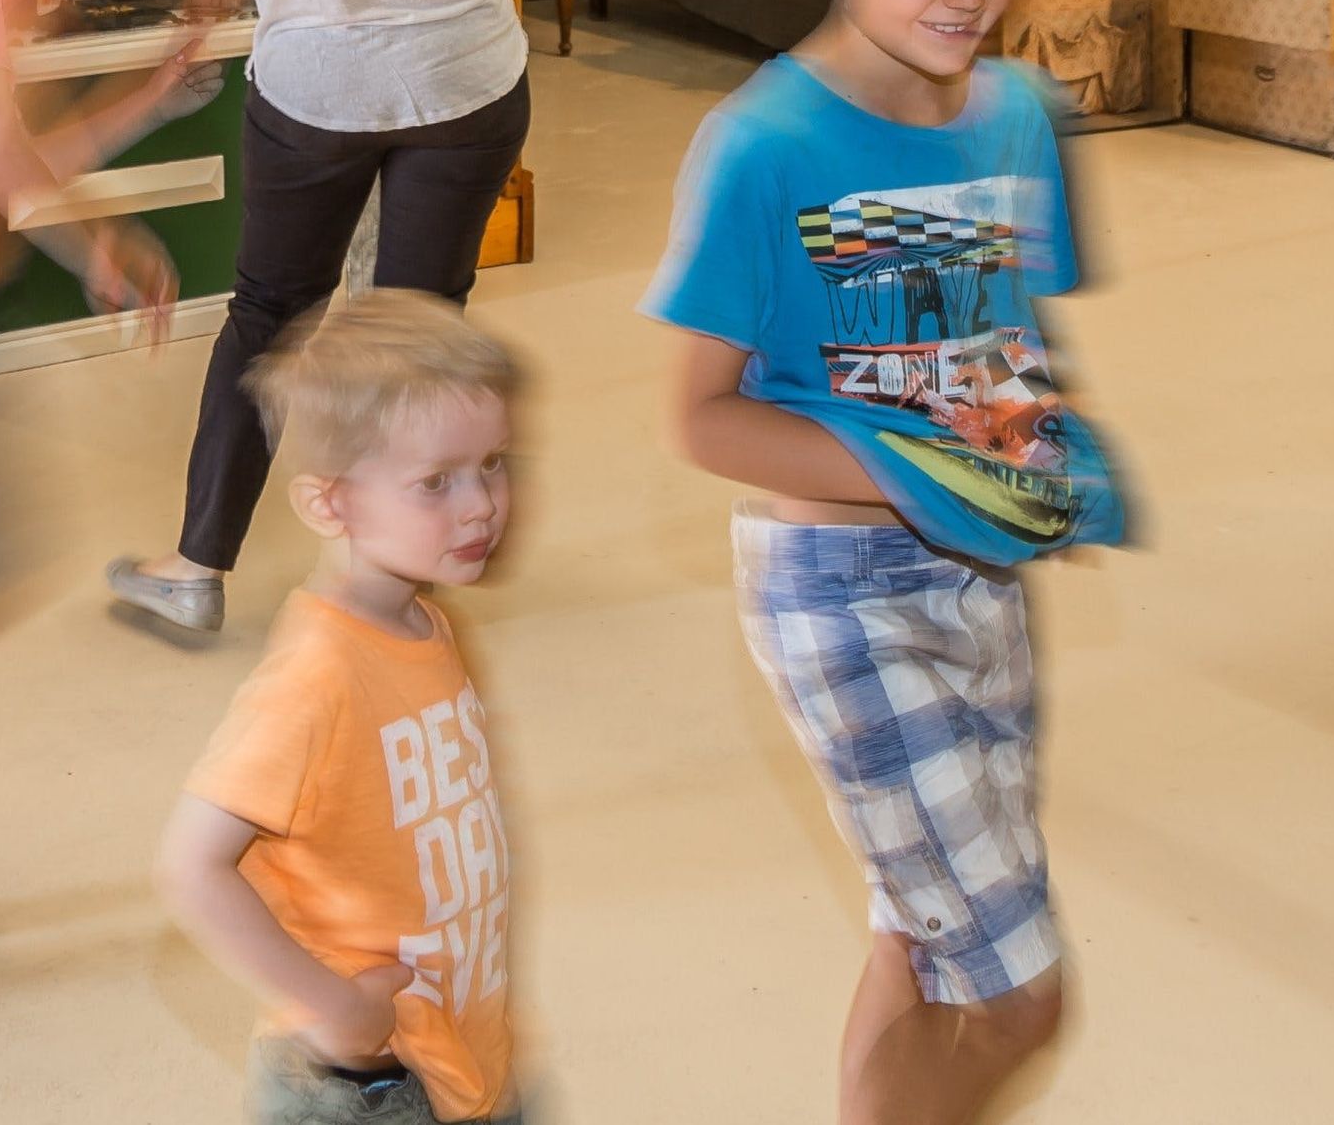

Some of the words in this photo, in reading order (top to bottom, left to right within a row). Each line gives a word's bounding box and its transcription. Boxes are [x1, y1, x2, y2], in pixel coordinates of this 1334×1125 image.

[838, 348, 968, 398] ZONE
[380, 677, 491, 830] BES
[398, 887, 509, 1017] EVE
